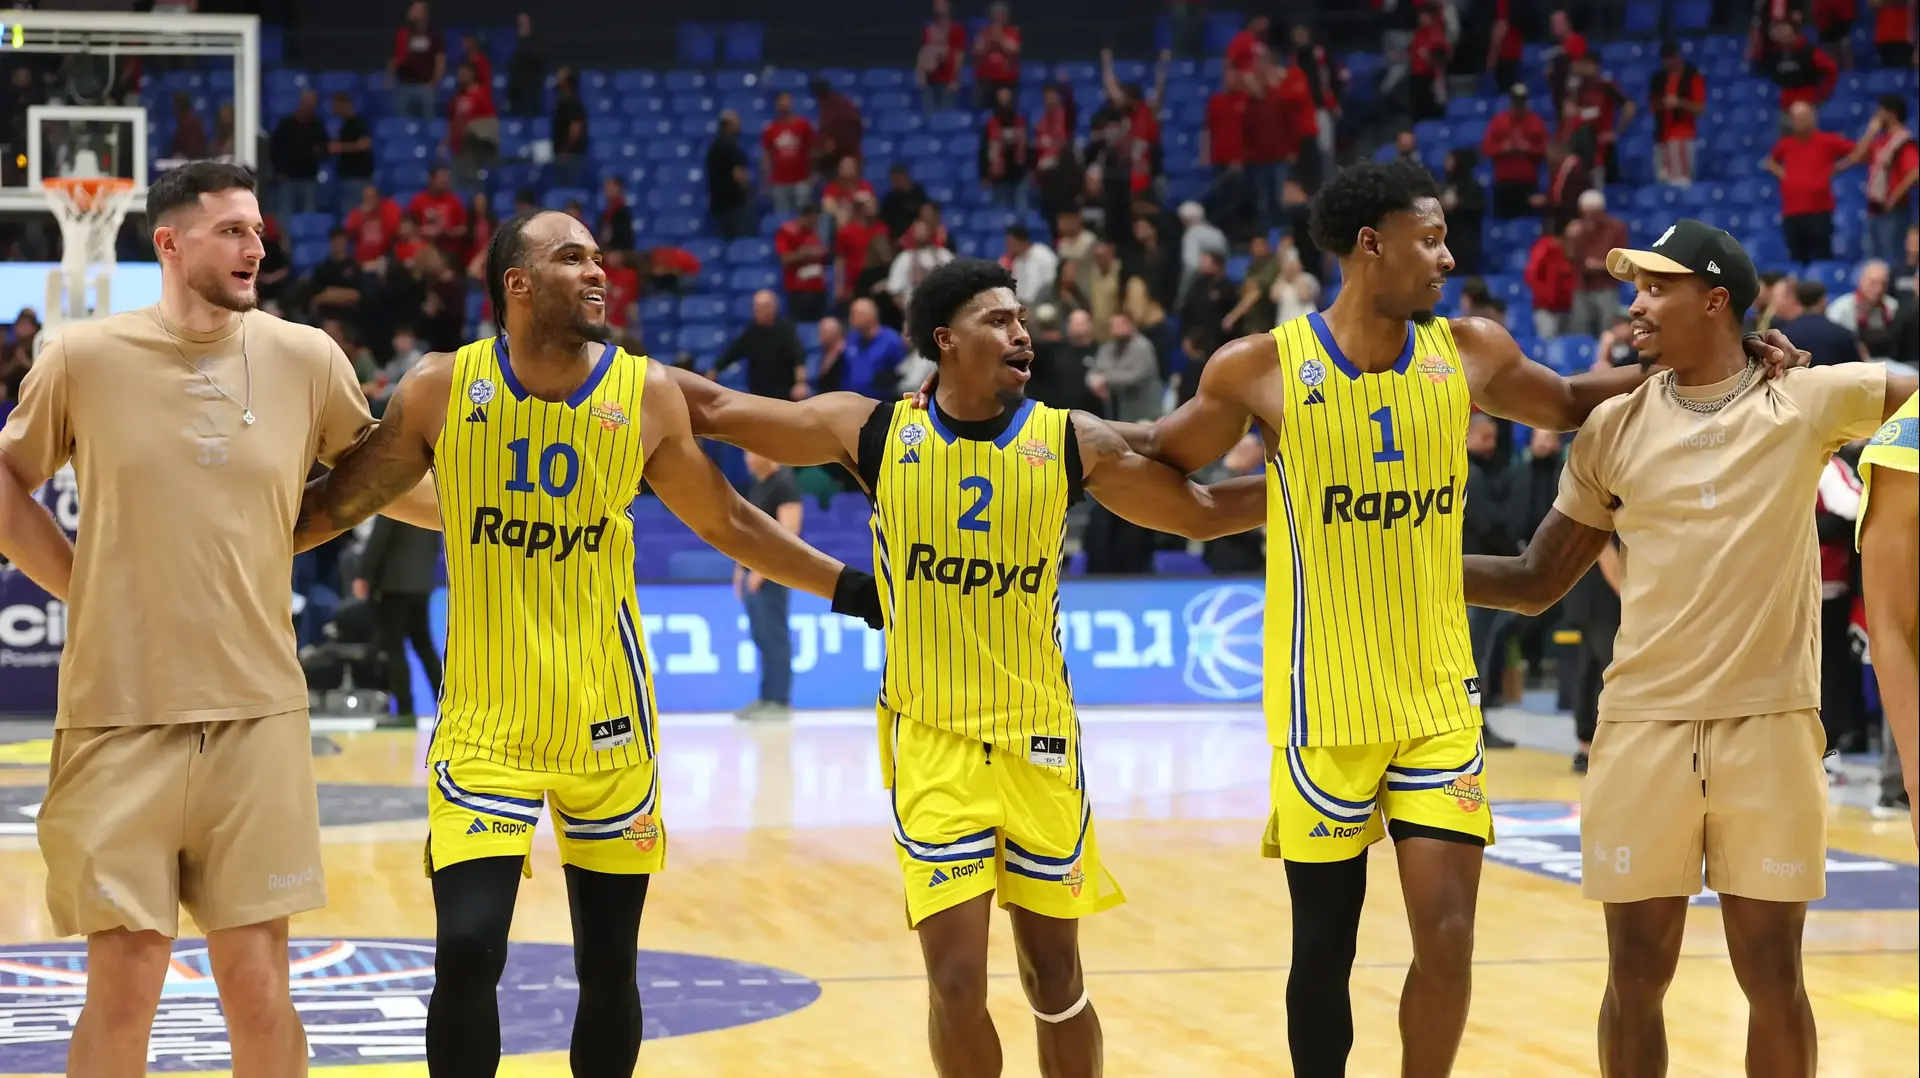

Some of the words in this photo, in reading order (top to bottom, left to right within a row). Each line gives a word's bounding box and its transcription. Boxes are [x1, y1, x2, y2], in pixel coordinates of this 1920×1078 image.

[591, 406, 622, 423] Winner
[1369, 406, 1405, 463] 1
[1015, 445, 1047, 459] Winner
[505, 438, 579, 498] 10
[957, 475, 994, 532] 2
[1323, 475, 1456, 530] Rapyd
[471, 507, 610, 562] Rapyd
[906, 543, 1048, 598] Rapyd
[1444, 784, 1480, 801] Winner
[492, 822, 527, 836] Rapyd
[622, 829, 656, 840] Winner
[951, 858, 984, 879] Rapyd
[1615, 846, 1631, 873] 8
